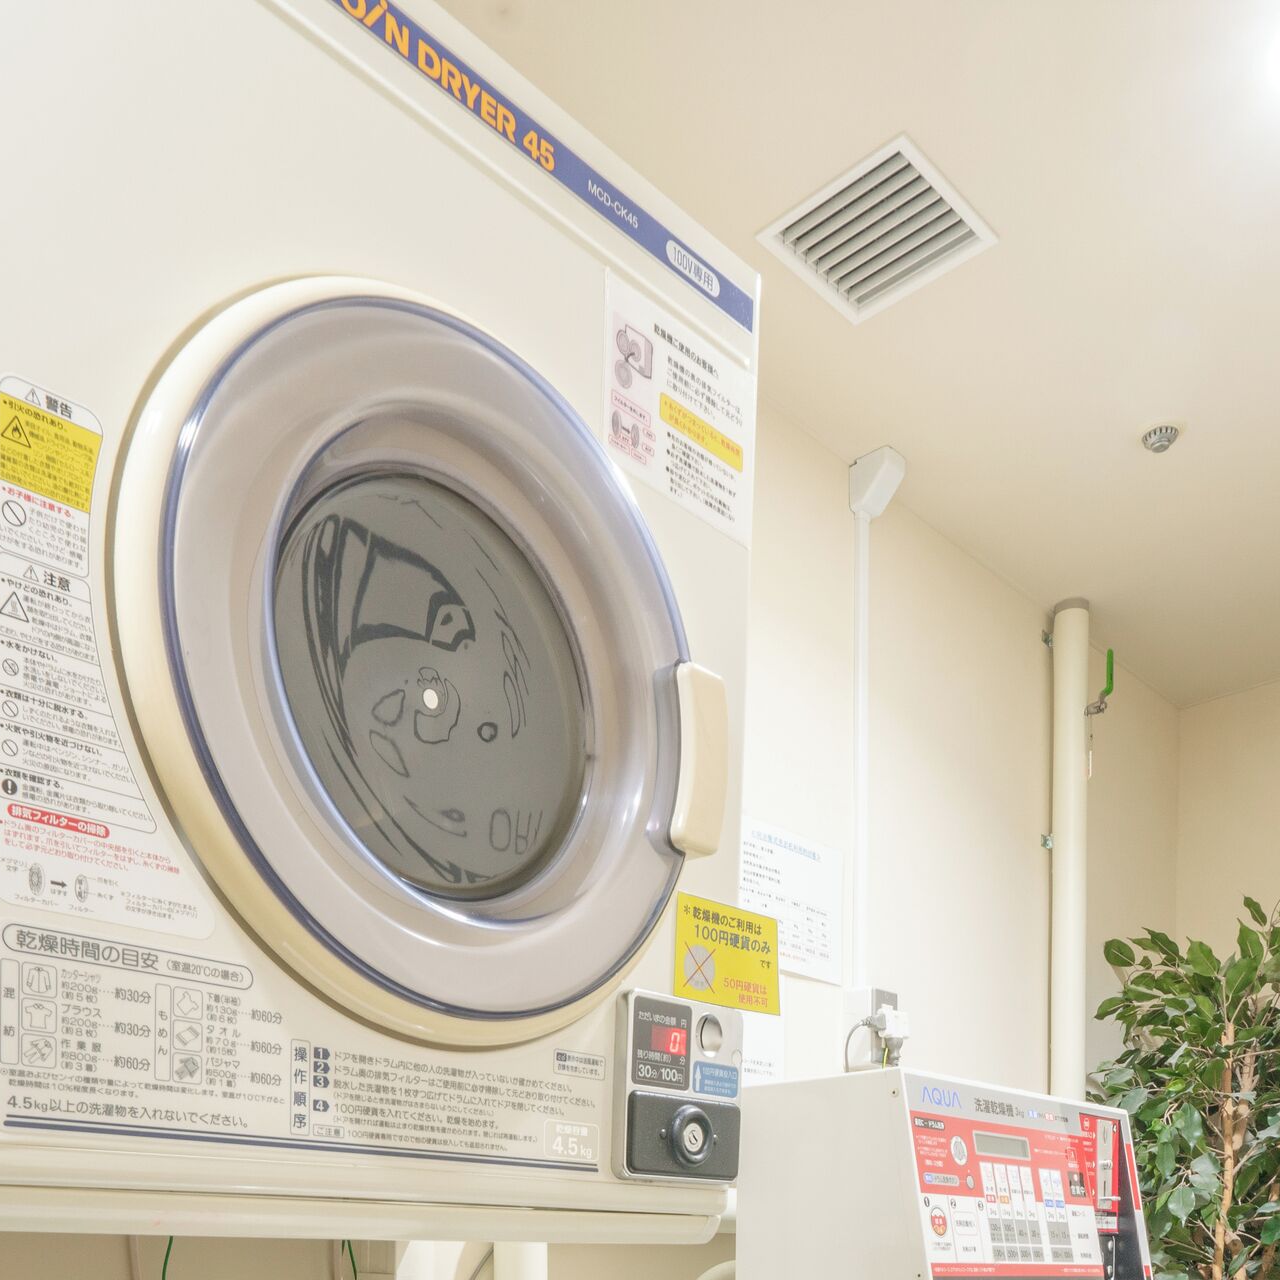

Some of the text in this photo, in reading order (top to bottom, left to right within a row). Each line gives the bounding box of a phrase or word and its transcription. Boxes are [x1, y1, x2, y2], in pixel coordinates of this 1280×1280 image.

[418, 38, 555, 172] DRYER 45
[588, 179, 638, 229] MCD-CK45
[671, 244, 716, 292] 100V専用
[10, 400, 67, 433] 引火の恐れあり。
[7, 578, 72, 607] やけどの恐れあり。
[44, 571, 71, 593] 注意
[6, 641, 57, 663] 水をかけない。
[6, 690, 88, 720] 衣類は十分に脱水する。
[6, 725, 102, 756] 火気や引火物を近づけない。
[5, 769, 64, 790] 衣類を確認する。
[12, 805, 105, 837] 排気フィルターの掃除
[692, 905, 762, 936] 乾燥機のご利用は
[694, 923, 771, 955] 100円硬貨のみ
[16, 929, 160, 972] 乾燥時間の目安
[760, 959, 772, 969] です
[114, 987, 151, 1005] 約30分
[723, 977, 768, 996] 50円硬貨は
[61, 1003, 102, 1019] ブラウス
[738, 993, 768, 1008] 使用不可
[250, 1009, 282, 1025] 約60分
[680, 1018, 688, 1029] 円
[114, 1021, 151, 1038] 約30分
[158, 1009, 168, 1057] もめん
[206, 1024, 241, 1038] タオル
[250, 1041, 282, 1056] 約60分
[669, 1031, 680, 1053] 0
[113, 1055, 150, 1072] 約60分
[206, 1057, 241, 1070] パジャマ
[250, 1072, 282, 1087] 約60分
[293, 1046, 308, 1129] 操作順序
[922, 1085, 963, 1109] AQUA
[973, 1097, 1015, 1118] 洗濯乾燥機
[6, 1095, 248, 1129] 4.5kg以上の洗濯物を入れないでください。
[334, 1102, 499, 1129] 100円硬貨を入れてください。乾燥を始めます。
[552, 1135, 578, 1156] 4.5
